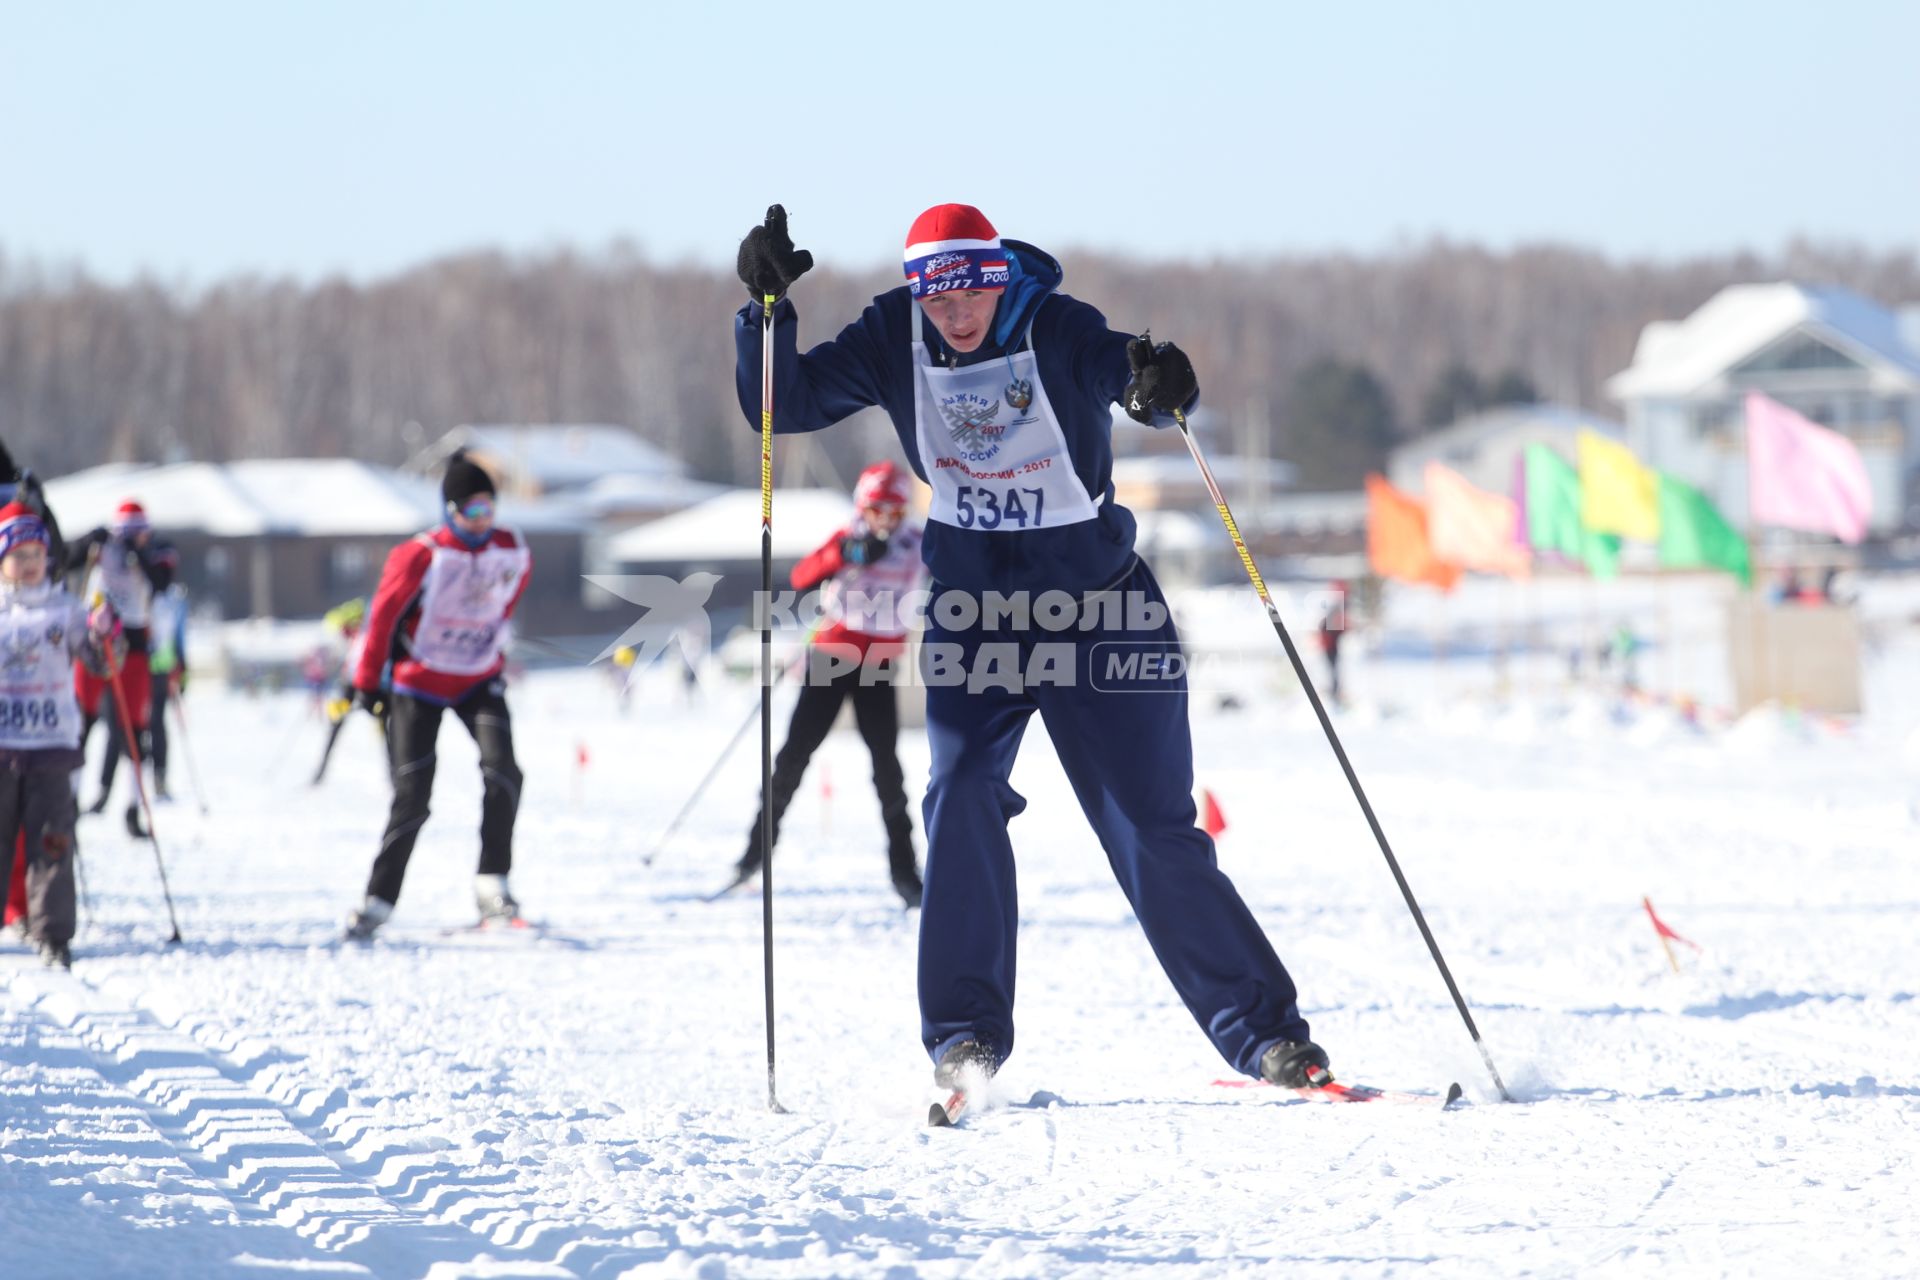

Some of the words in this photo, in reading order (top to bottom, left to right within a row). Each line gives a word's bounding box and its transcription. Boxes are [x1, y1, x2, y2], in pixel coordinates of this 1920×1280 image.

[927, 279, 973, 295] 2017
[981, 425, 1006, 435] 2017
[959, 444, 1000, 461] ОССИИ
[935, 457, 971, 476] ЛЫЖНЯ
[1024, 458, 1051, 473] 2017
[956, 486, 1044, 529] 5347
[1216, 503, 1242, 543] power
[1236, 545, 1267, 598] emotion
